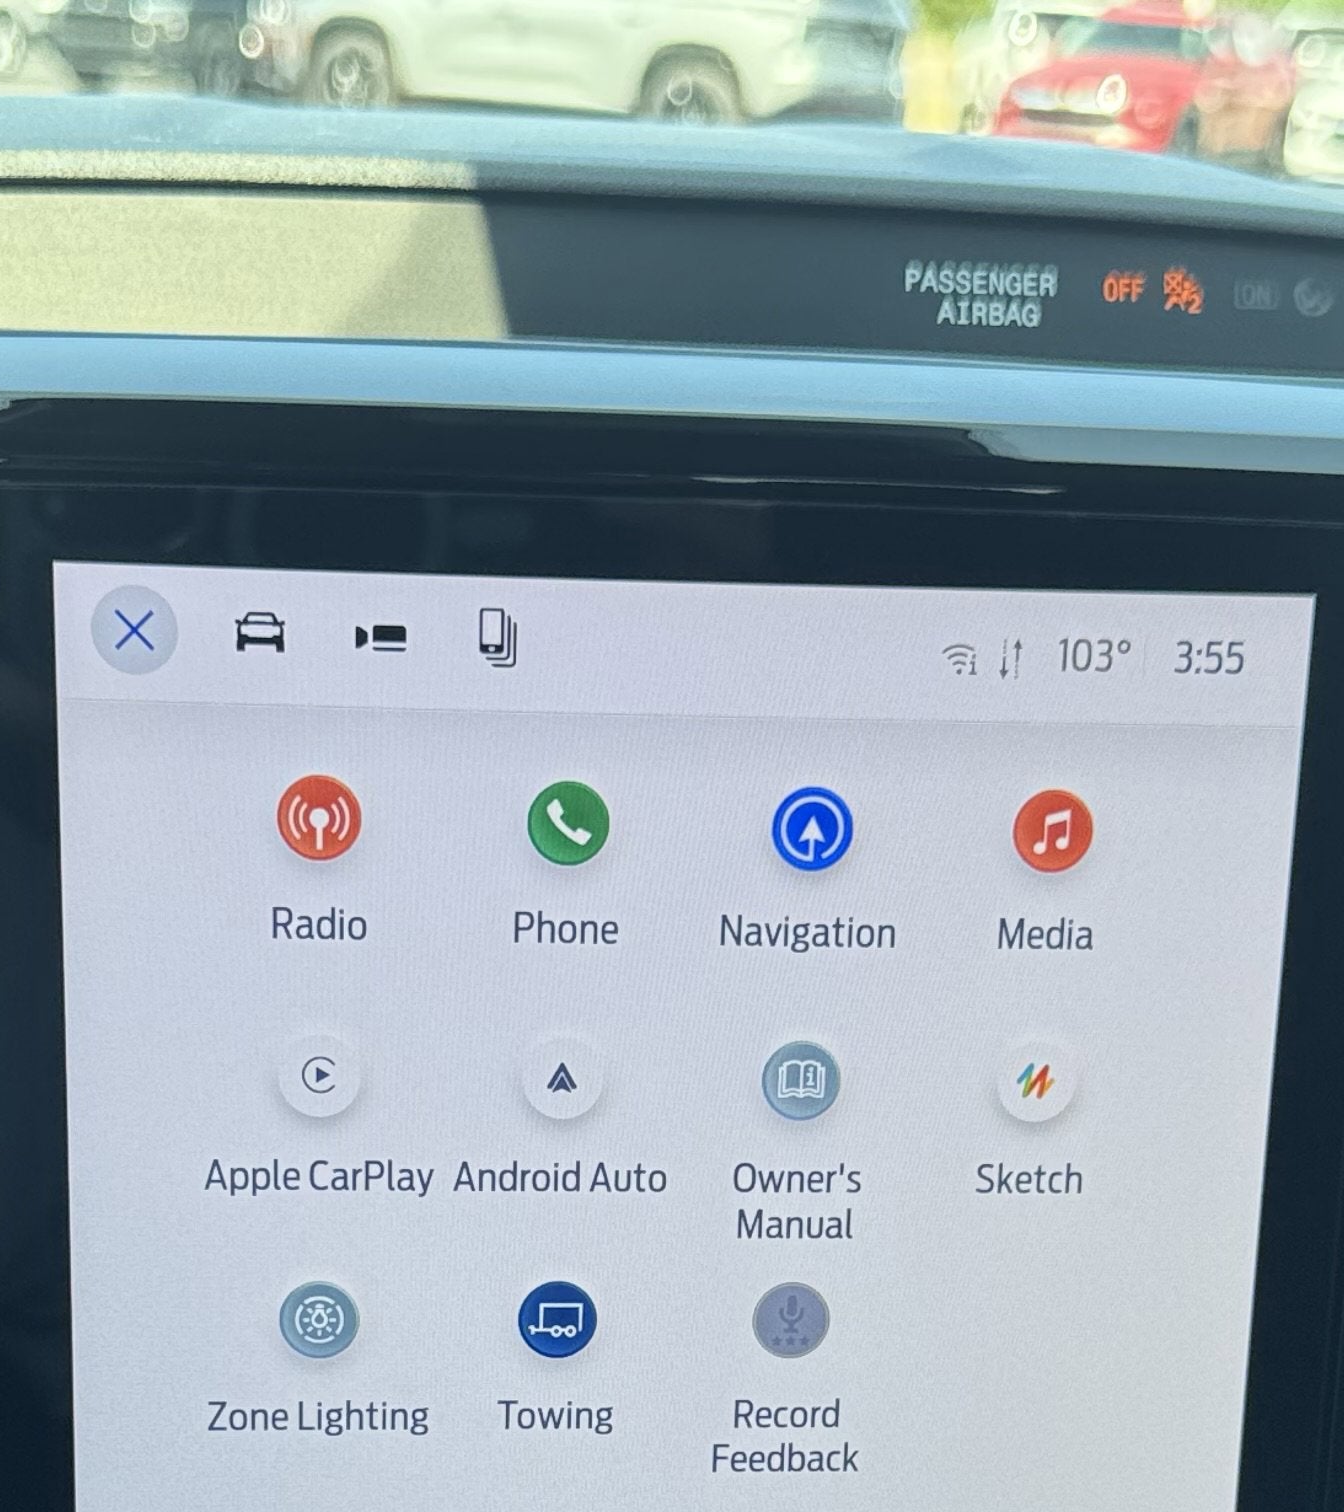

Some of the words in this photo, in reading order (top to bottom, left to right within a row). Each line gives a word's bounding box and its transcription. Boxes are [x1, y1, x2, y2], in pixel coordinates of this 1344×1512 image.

[904, 265, 1058, 298] PASSENGER
[1103, 274, 1144, 302] OFF
[1241, 284, 1271, 306] ON
[937, 300, 1041, 328] AIRBAG
[1059, 638, 1132, 673] 103°
[1174, 640, 1245, 675] 3:55
[272, 906, 367, 941] Radio
[514, 910, 619, 945] Phone
[719, 914, 896, 954] Navigation
[997, 916, 1093, 951] Media
[204, 1158, 301, 1197] Apple
[309, 1159, 435, 1198] CarPlay
[453, 1160, 581, 1192] Android
[589, 1161, 667, 1193] Auto
[733, 1162, 861, 1194] Owner's
[975, 1162, 1083, 1194] Sketch
[737, 1207, 853, 1240] Manual
[207, 1400, 289, 1432] Zone
[298, 1399, 429, 1437] Lighting
[497, 1399, 614, 1435] Towing
[733, 1397, 840, 1429] Record
[711, 1441, 859, 1473] Feedback
